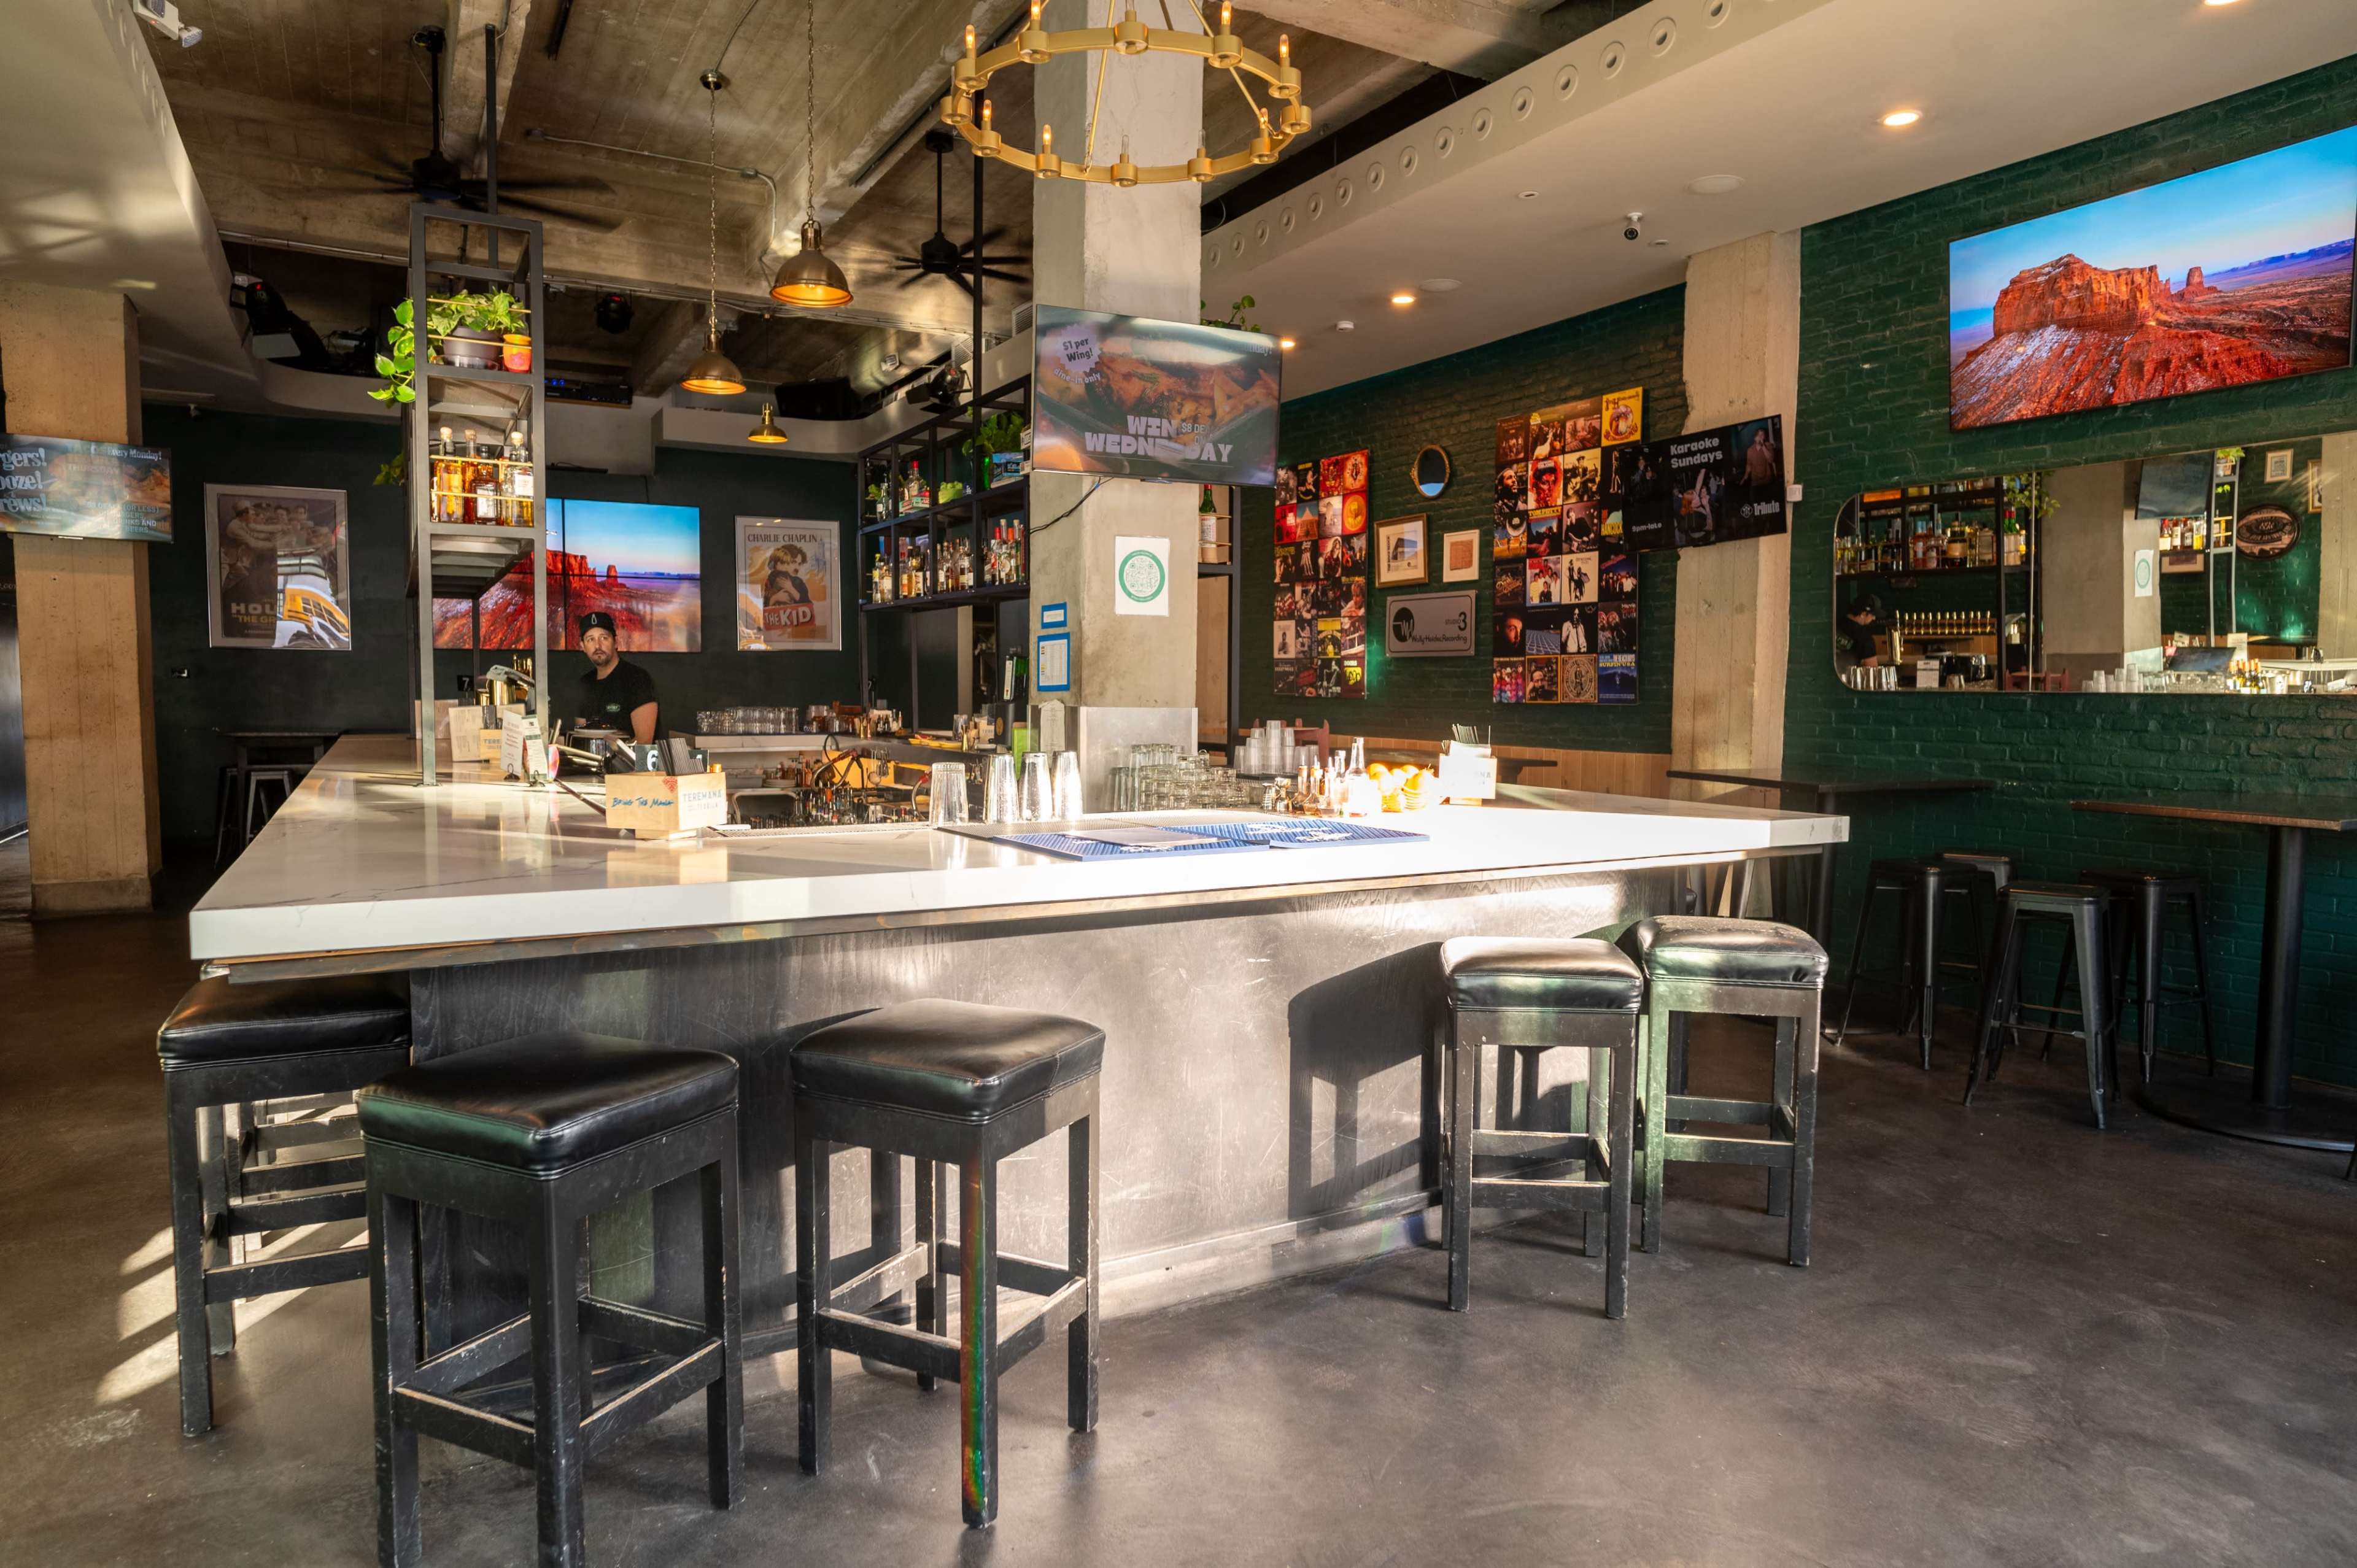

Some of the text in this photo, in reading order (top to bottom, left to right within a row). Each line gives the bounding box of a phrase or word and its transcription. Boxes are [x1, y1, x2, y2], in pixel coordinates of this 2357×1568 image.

[1062, 337, 1090, 352] $1 per
[1066, 346, 1094, 363] Wing!
[1054, 368, 1101, 384] dine-in only
[1182, 422, 1193, 433] $8
[1670, 436, 1719, 456] Karaoke
[129, 448, 162, 462] Monday!
[1670, 451, 1723, 469] Sundays
[1754, 500, 1780, 516] Tribute
[1631, 522, 1662, 533] 9pm-late
[748, 533, 818, 543] CHARLIE CHAPLIN
[765, 606, 813, 627] THE KID
[1458, 611, 1468, 631] 3
[462, 677, 470, 691] 7
[646, 749, 659, 772] 6
[683, 789, 722, 801] TEREMANA
